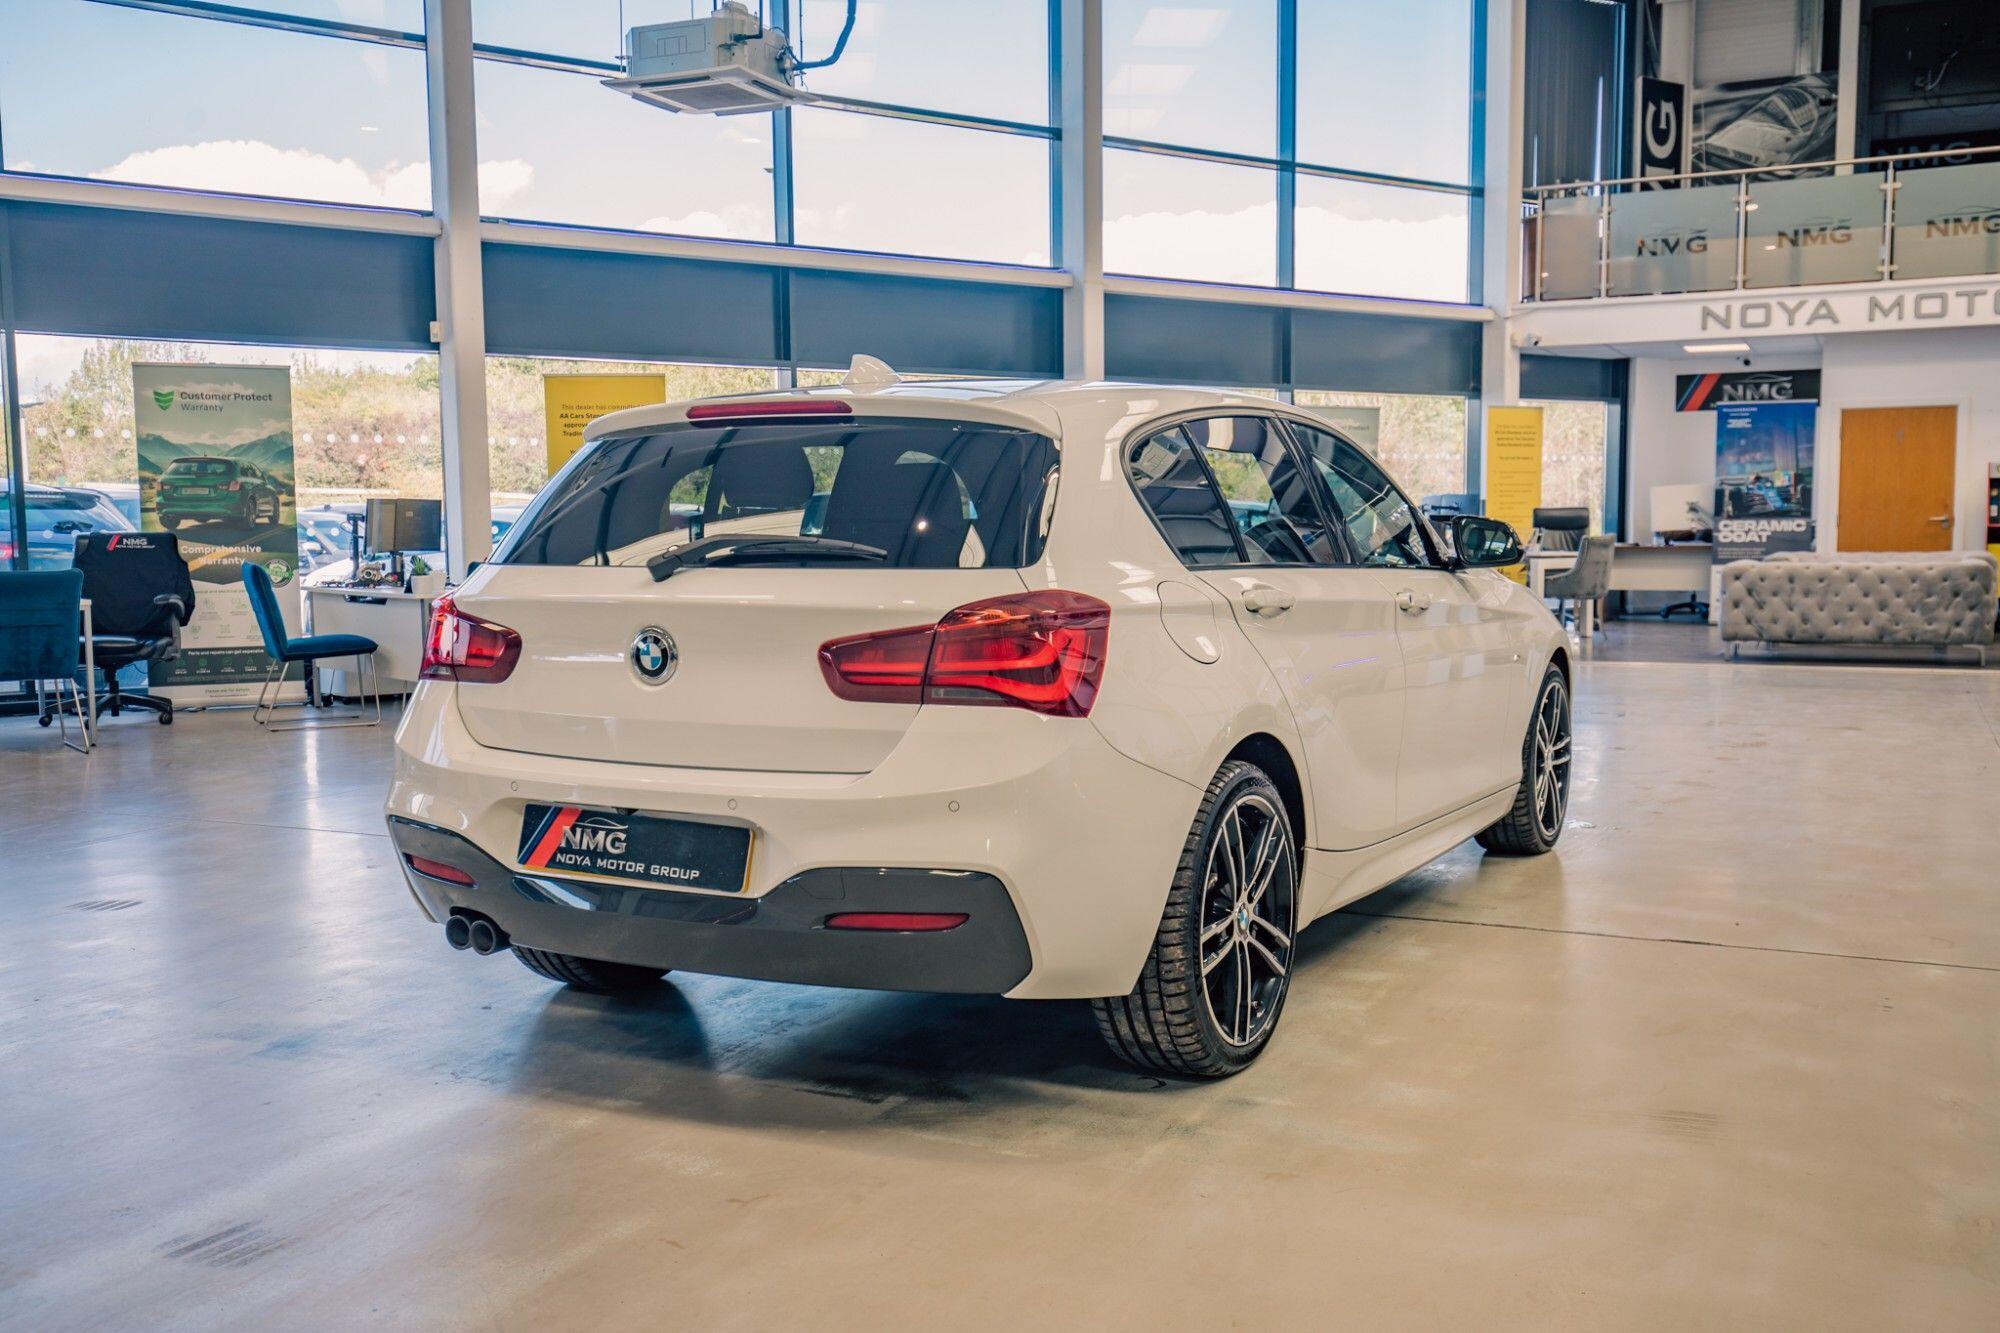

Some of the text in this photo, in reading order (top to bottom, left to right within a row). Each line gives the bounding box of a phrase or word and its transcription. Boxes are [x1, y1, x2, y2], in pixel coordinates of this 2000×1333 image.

[1777, 225, 1853, 248] NMG
[1637, 236, 1708, 257] NMG
[1701, 289, 2000, 331] NOYA MOT
[180, 391, 273, 402] Customer Protect
[1722, 382, 1793, 402] NMG
[181, 403, 224, 412] Warranty
[1718, 519, 1808, 533] CERAMIC
[122, 538, 148, 546] NMG
[1718, 531, 1772, 543] COAT
[182, 545, 262, 555] Comprehensive
[559, 826, 627, 854] NMG
[556, 852, 700, 880] NOYA MOTOR GROUP
